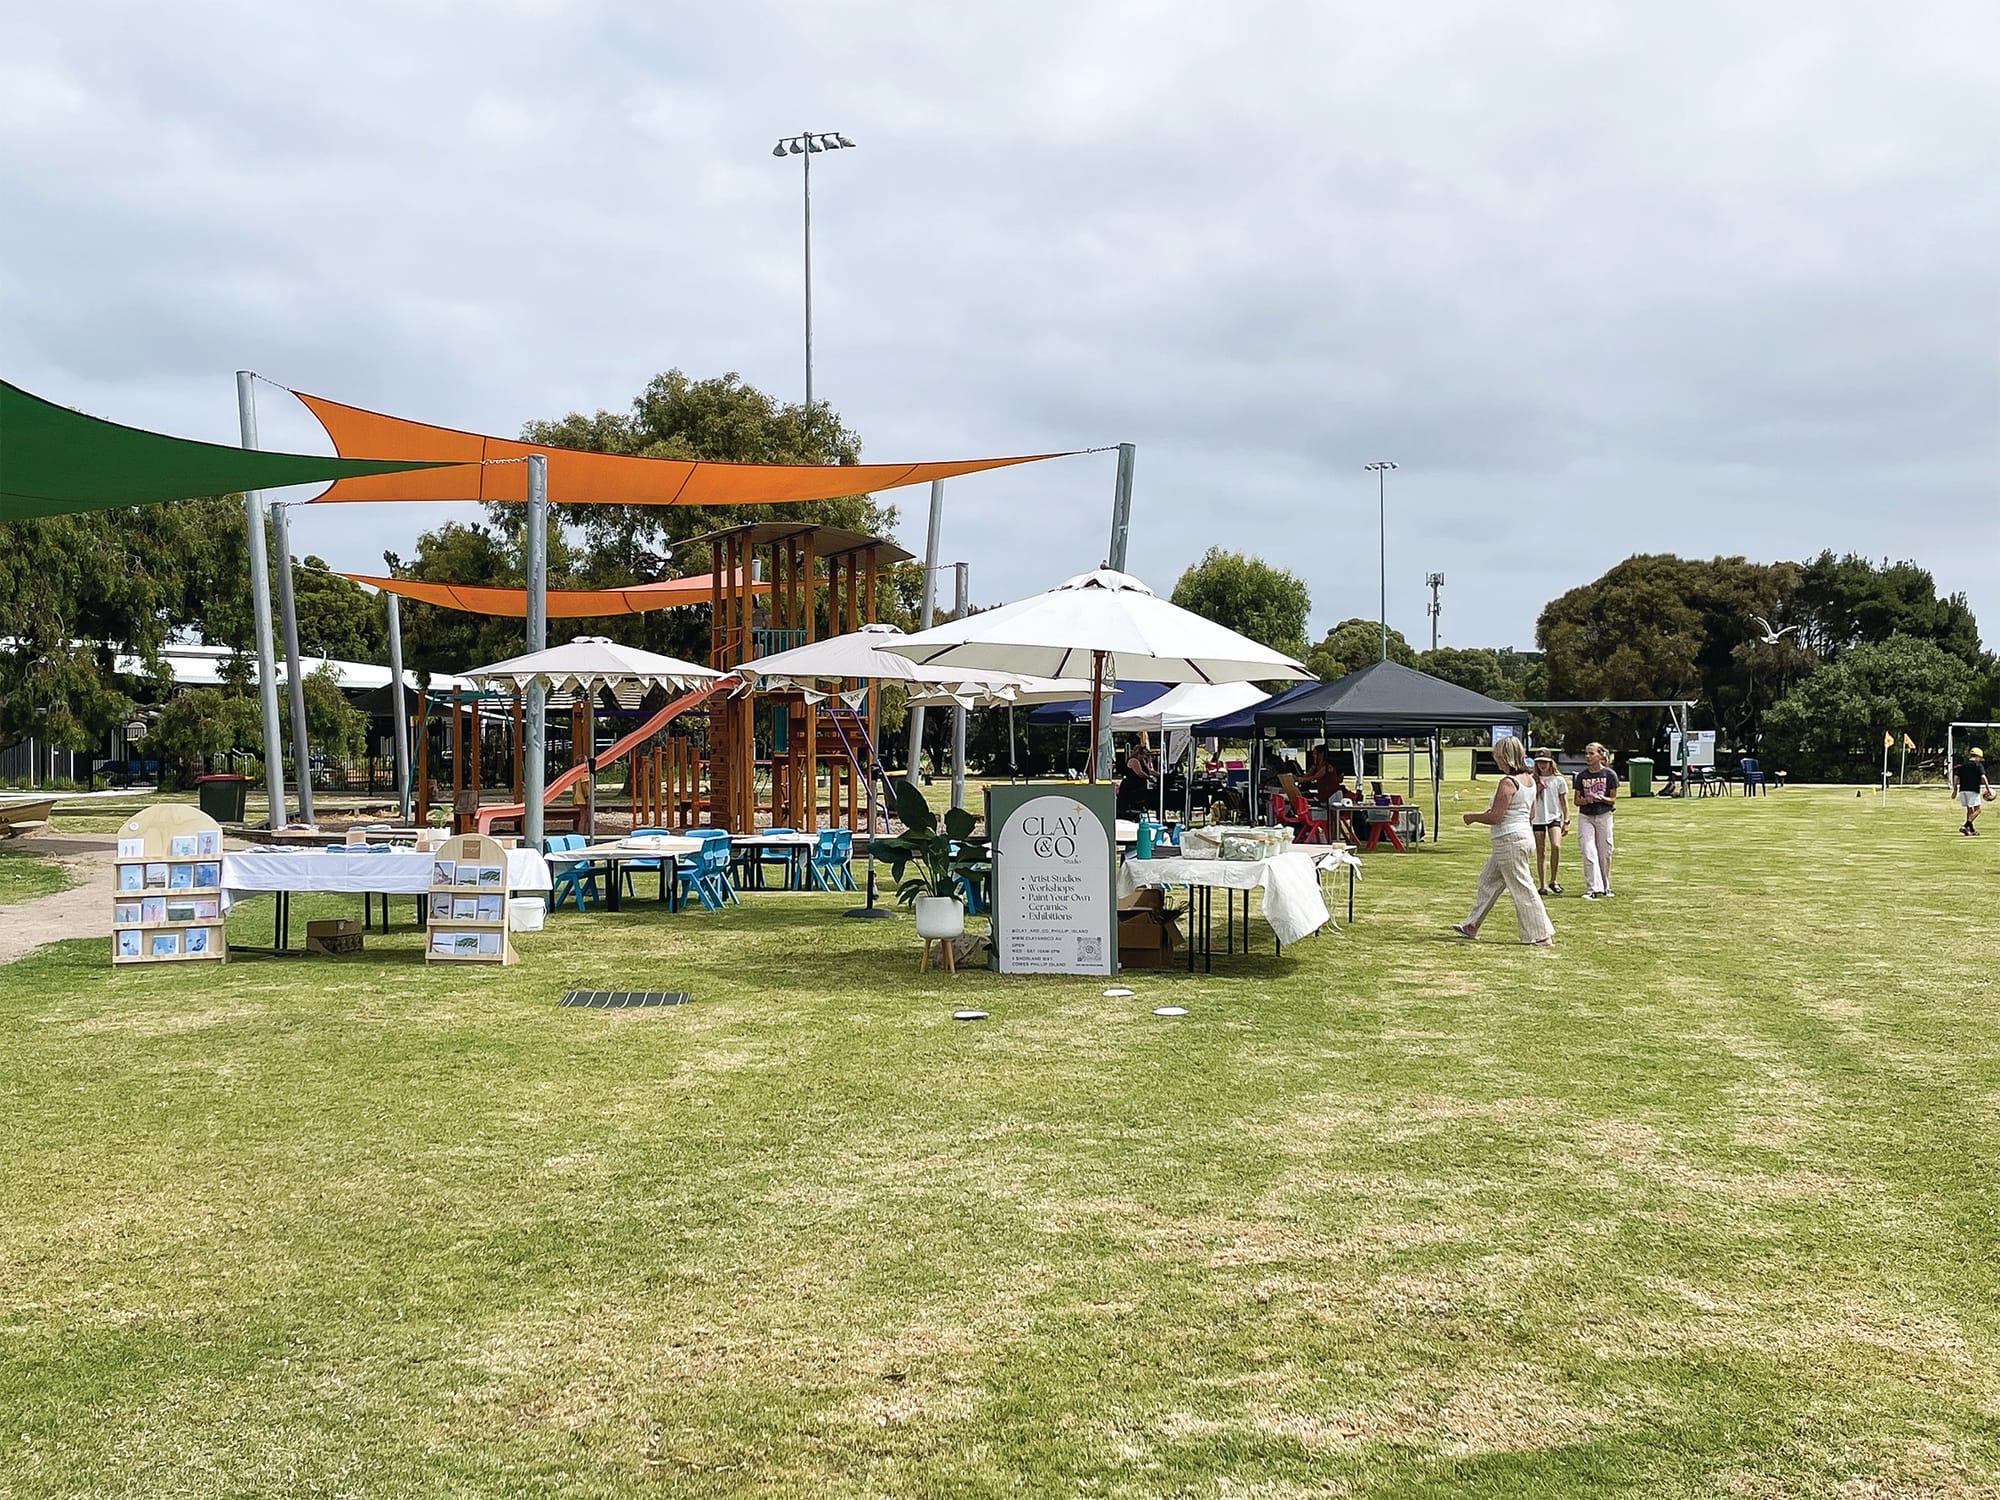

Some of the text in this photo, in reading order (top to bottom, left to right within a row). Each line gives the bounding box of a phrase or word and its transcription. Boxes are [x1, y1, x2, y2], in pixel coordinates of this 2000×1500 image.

[1022, 816, 1082, 836] CLAY
[1028, 873, 1082, 882] Artist Studios
[1028, 883, 1075, 894] Workshops
[1028, 893, 1091, 901] Paint Your Own
[1028, 902, 1068, 911] Ceramics
[1028, 911, 1073, 920] Exhibitions
